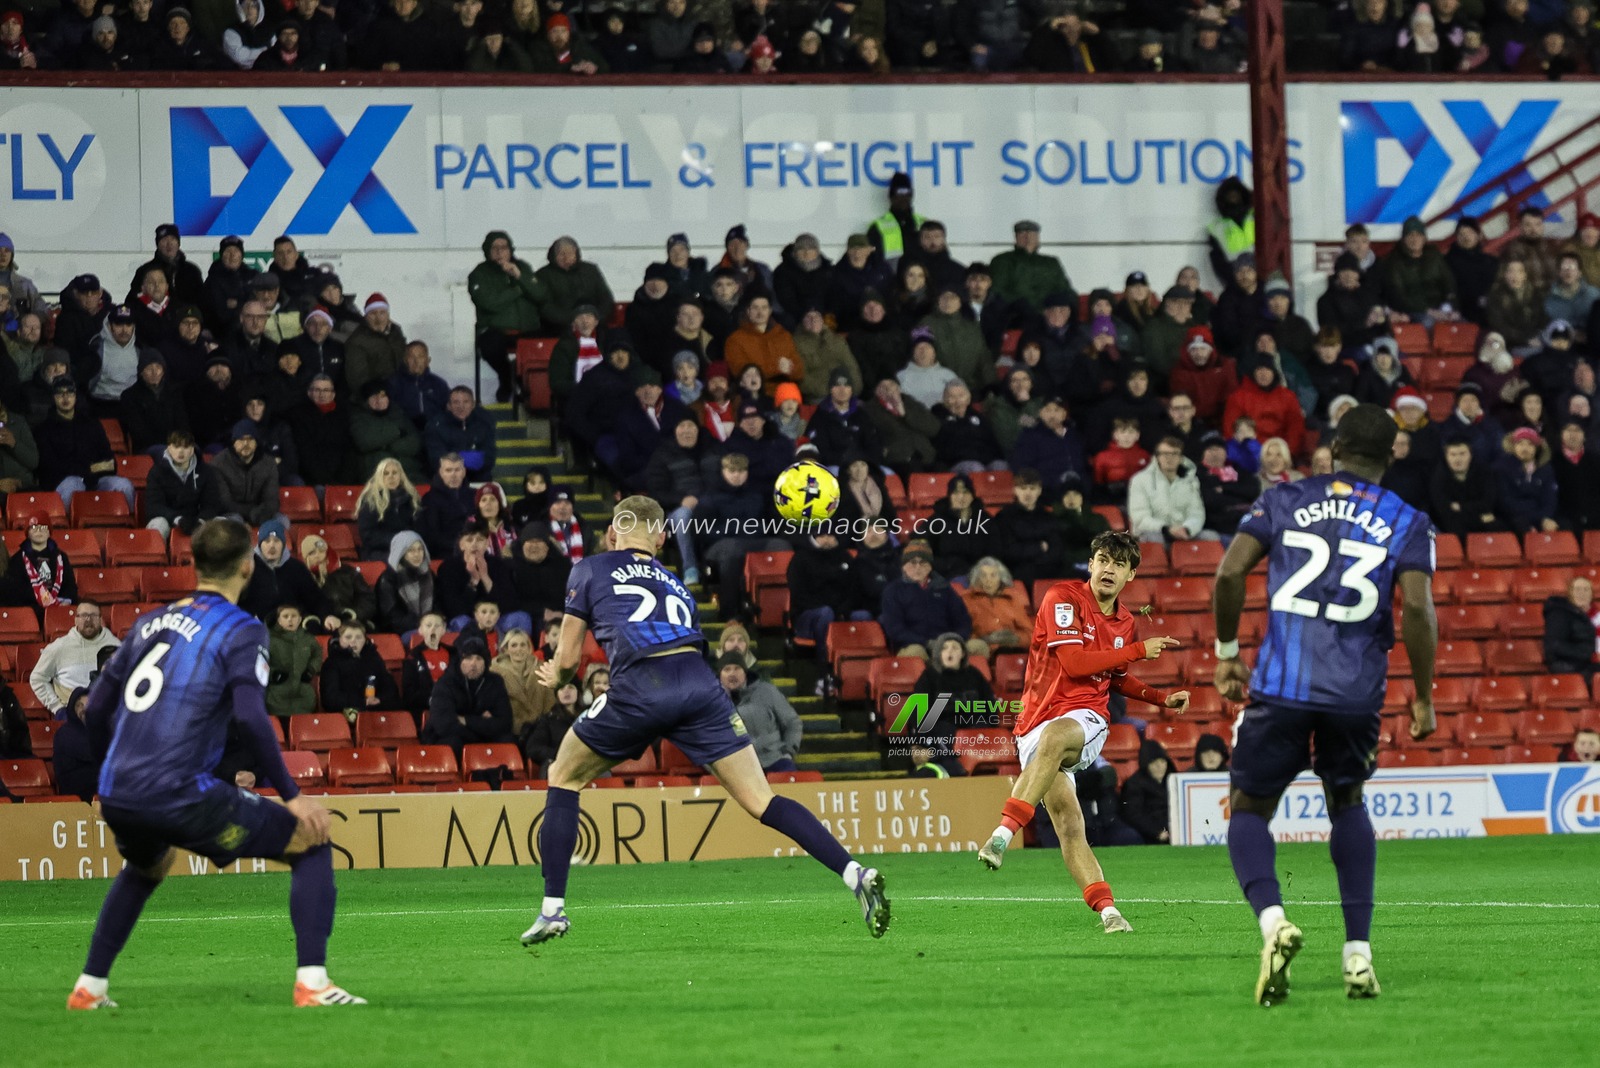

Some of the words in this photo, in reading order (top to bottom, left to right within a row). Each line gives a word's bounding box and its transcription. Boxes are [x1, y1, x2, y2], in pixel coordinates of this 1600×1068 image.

[0, 133, 96, 201] LY
[170, 104, 418, 236] DX
[434, 143, 652, 190] PARCEL
[679, 142, 716, 189] &
[745, 141, 975, 187] FREIGHT
[1340, 99, 1563, 224] DX
[1294, 499, 1392, 544] OSHILAJA
[1271, 529, 1388, 623] 23
[124, 642, 172, 713] 6
[817, 791, 859, 813] THE
[875, 788, 931, 812] UK'S
[1272, 794, 1328, 819] 122
[1362, 791, 1454, 818] 82312
[53, 820, 108, 849] GET
[820, 817, 861, 841] OST
[877, 815, 951, 839] LOVED
[18, 857, 54, 881] TO
